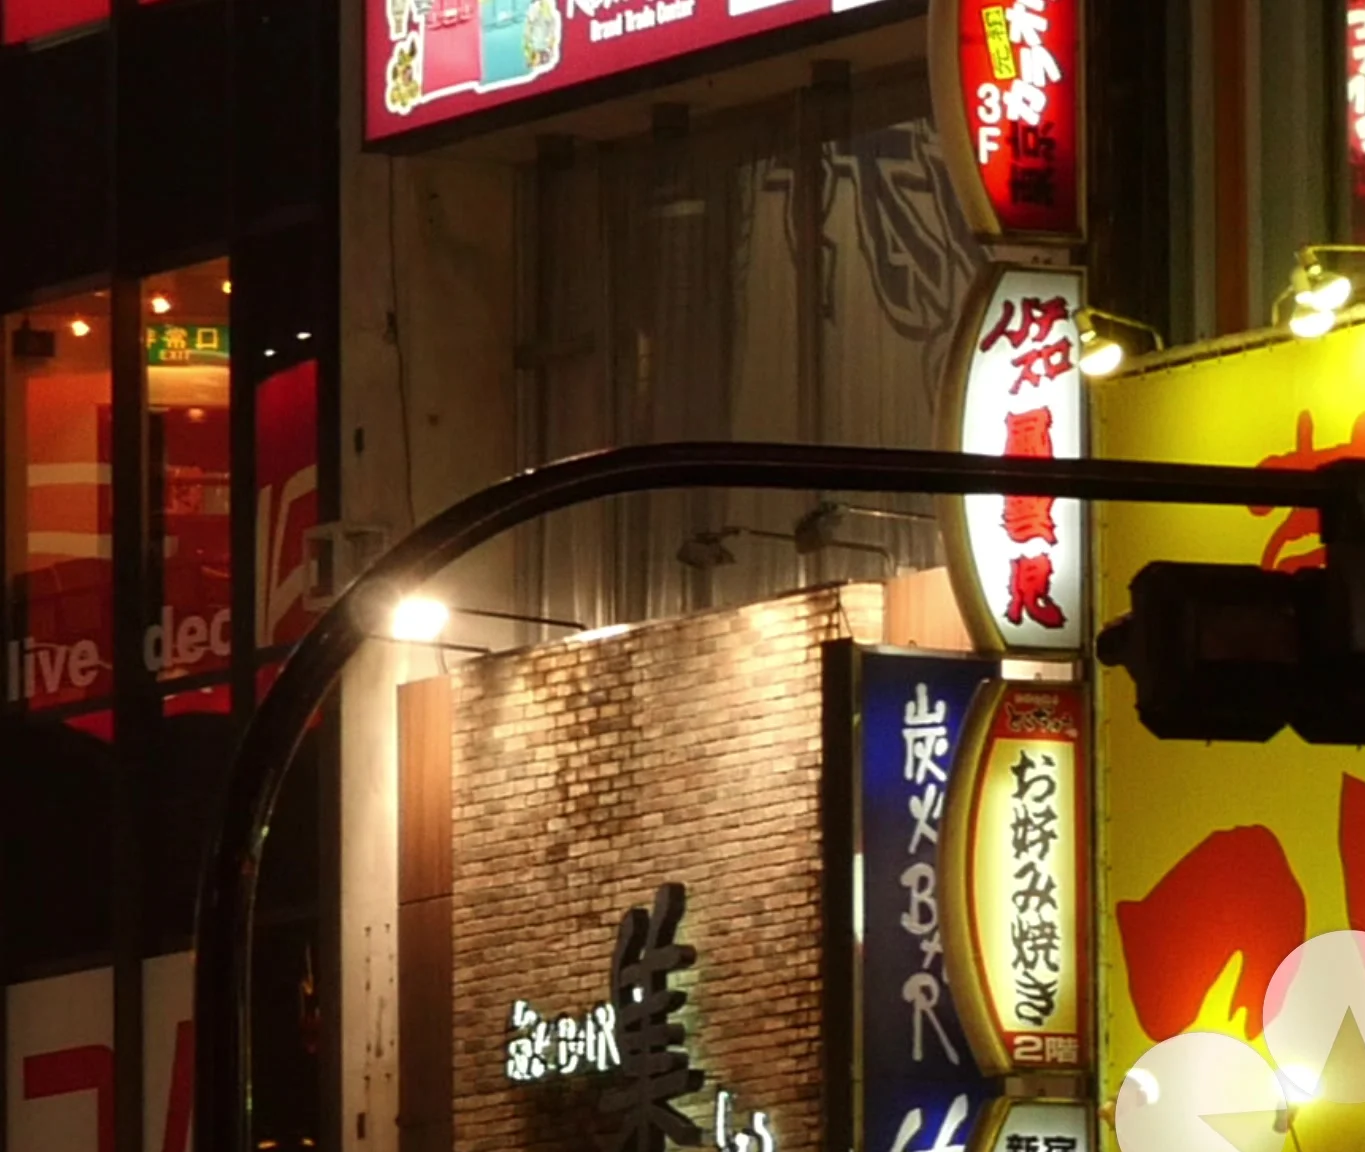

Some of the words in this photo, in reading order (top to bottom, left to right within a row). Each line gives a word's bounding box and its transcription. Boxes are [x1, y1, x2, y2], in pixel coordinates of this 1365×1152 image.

[590, 12, 623, 42] Brand
[624, 5, 656, 32] Trade
[8, 637, 100, 701] live
[1010, 750, 1060, 1026] お好み焼き
[1013, 1035, 1079, 1064] 2階
